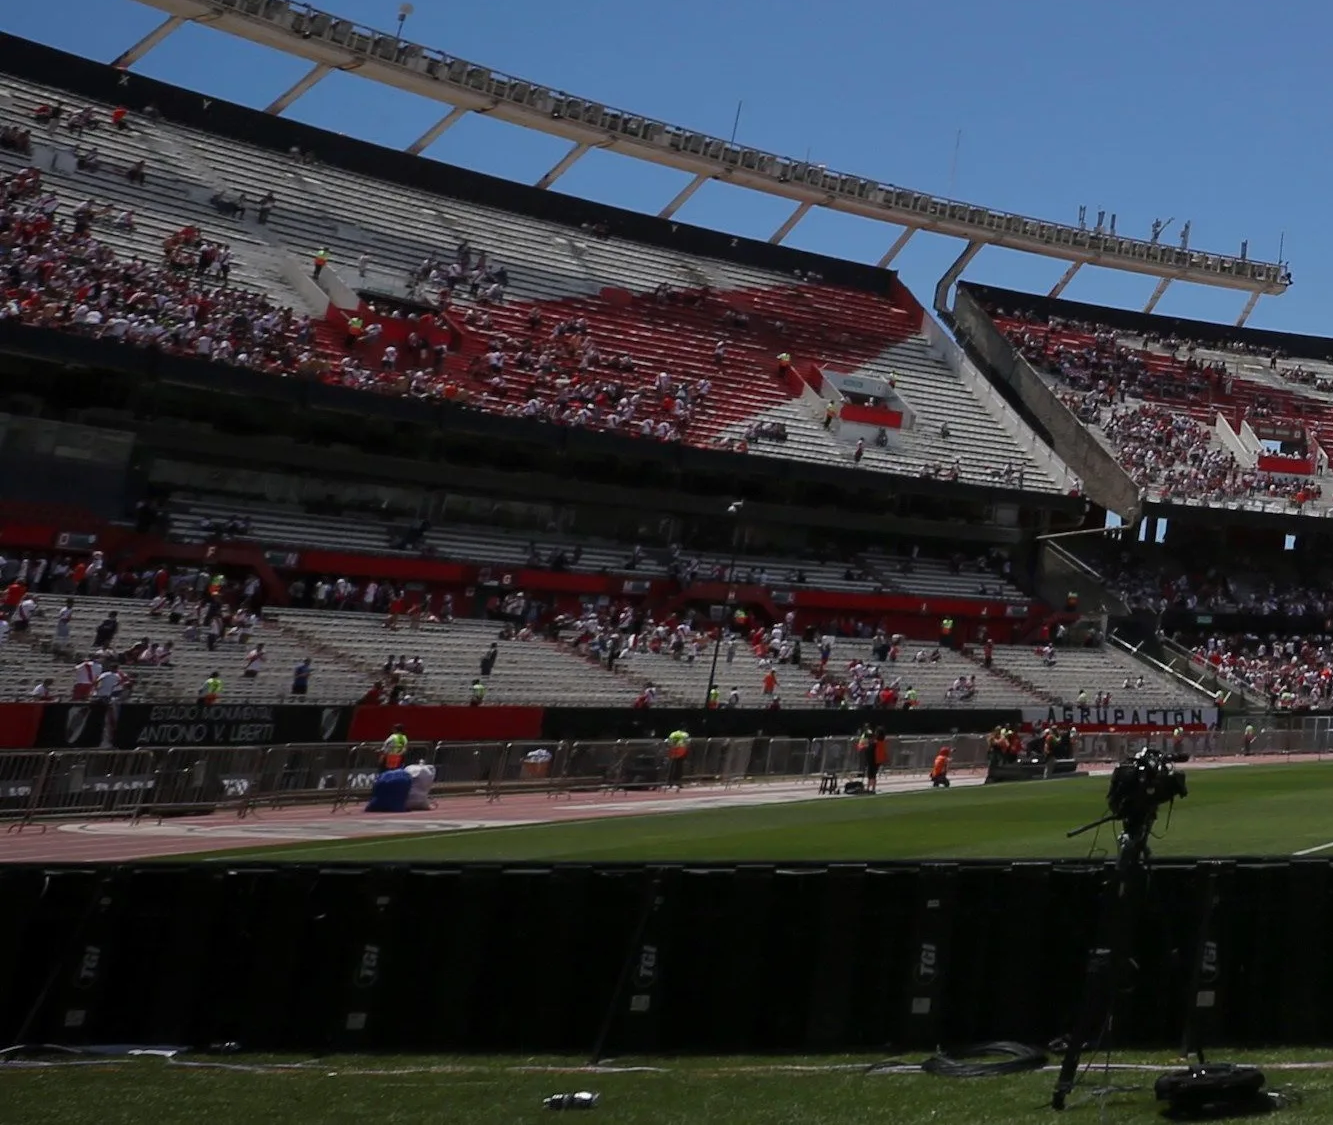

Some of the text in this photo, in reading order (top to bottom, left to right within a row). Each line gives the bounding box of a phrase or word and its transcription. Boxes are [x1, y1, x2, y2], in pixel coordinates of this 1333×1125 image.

[150, 706, 273, 721] ESTADIO MONUMENTAL
[138, 724, 275, 742] ANTONIO V. LIBERTI
[80, 944, 101, 979] TGI
[360, 944, 380, 979] TGI
[640, 944, 658, 977] TGI
[920, 942, 937, 976] TGI
[1201, 940, 1218, 974] TGI
